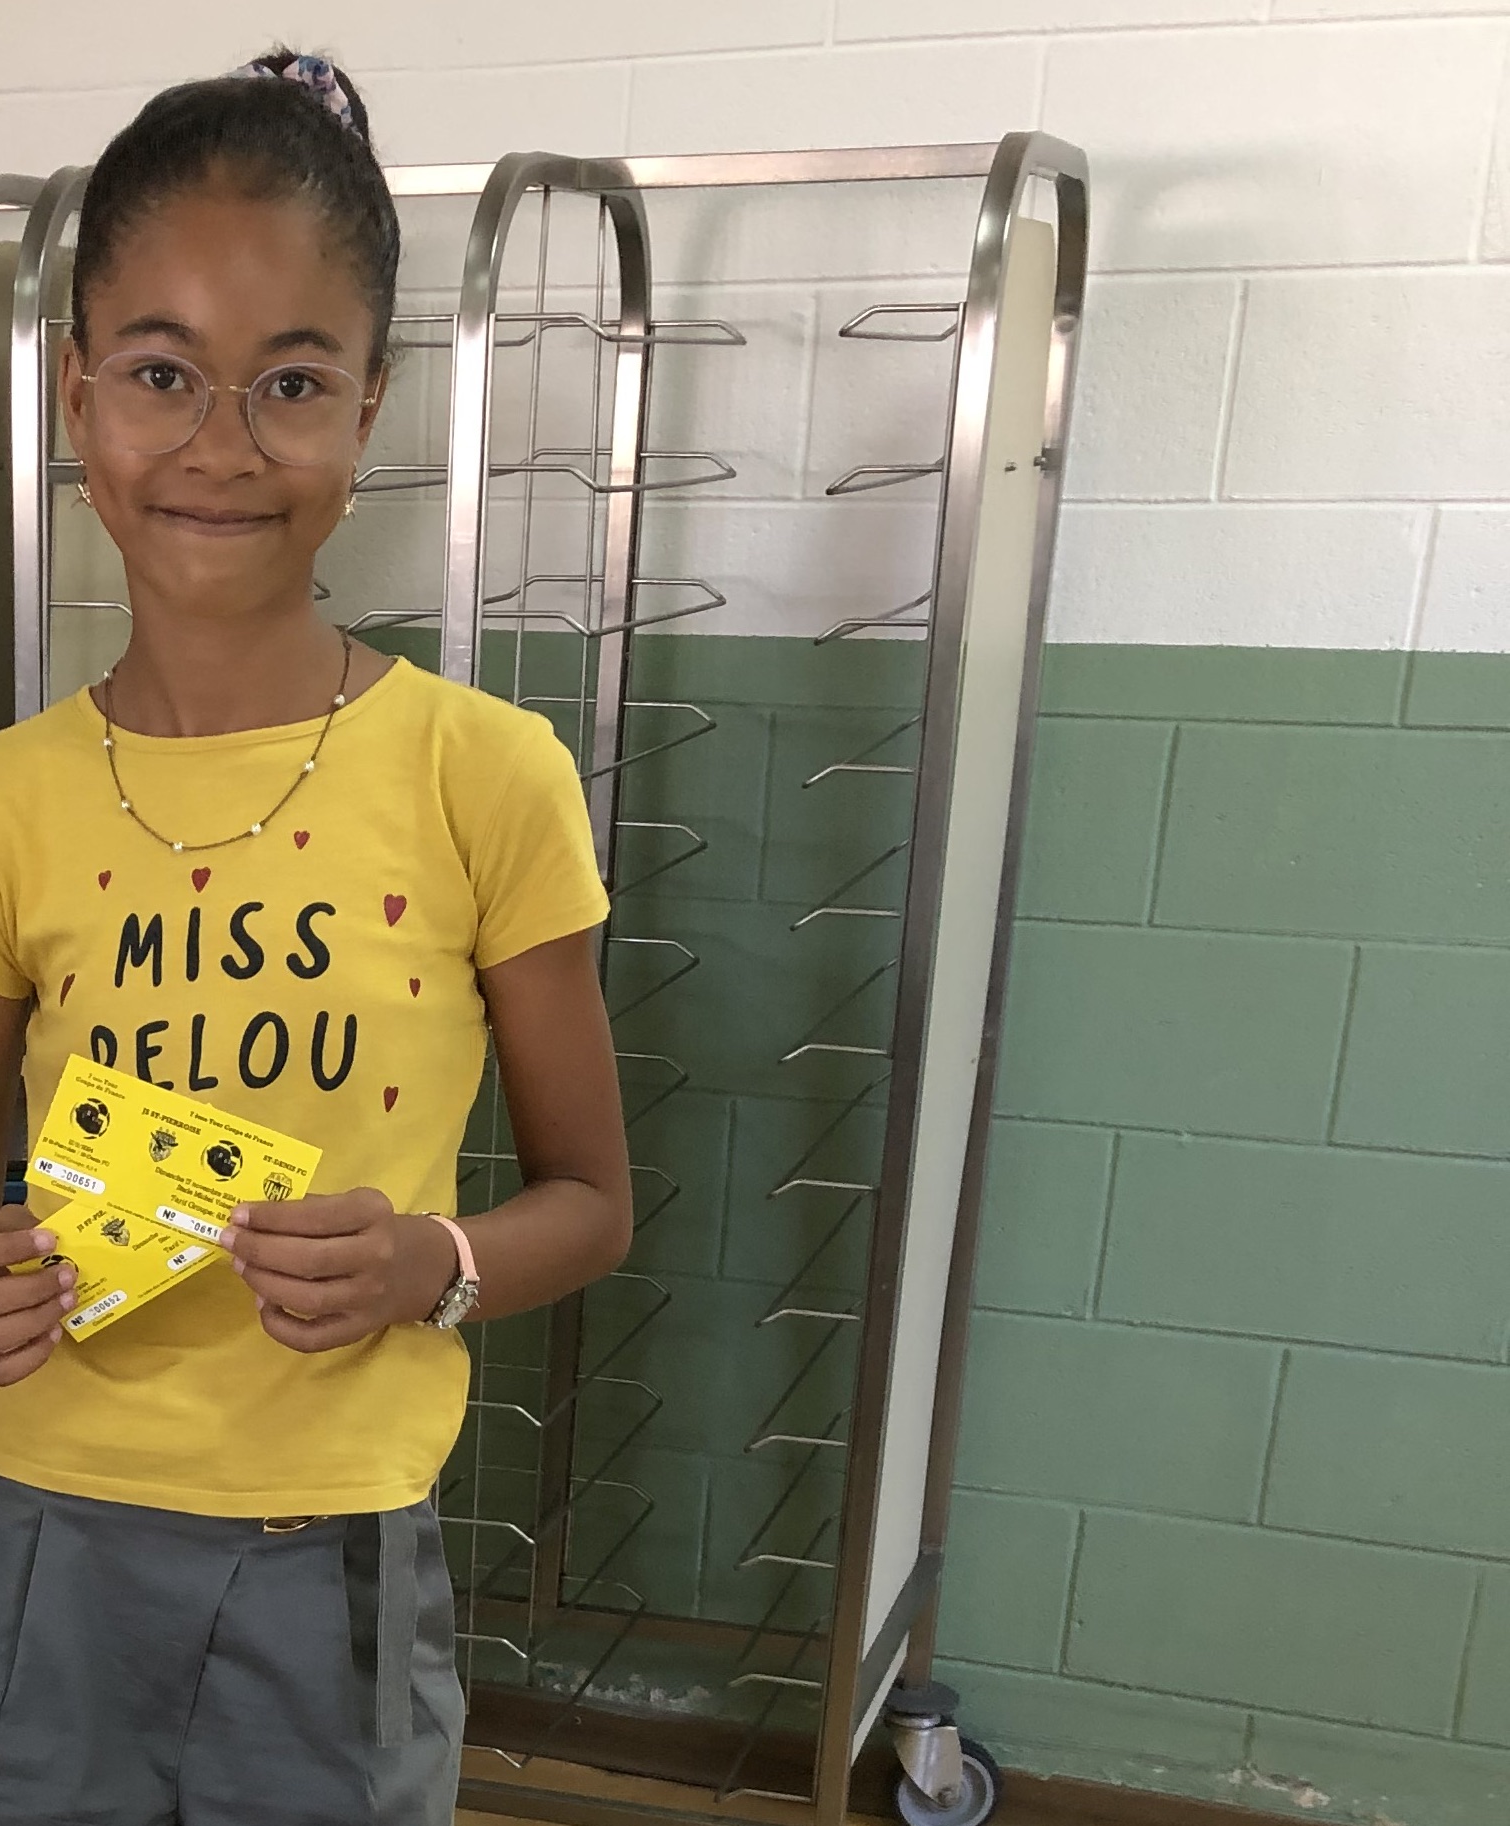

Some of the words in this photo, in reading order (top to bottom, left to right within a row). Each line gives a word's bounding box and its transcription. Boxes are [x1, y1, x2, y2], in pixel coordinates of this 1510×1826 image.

[114, 901, 336, 988] MISS
[263, 1154, 296, 1173] ST-DENIS
[296, 1166, 308, 1176] FC
